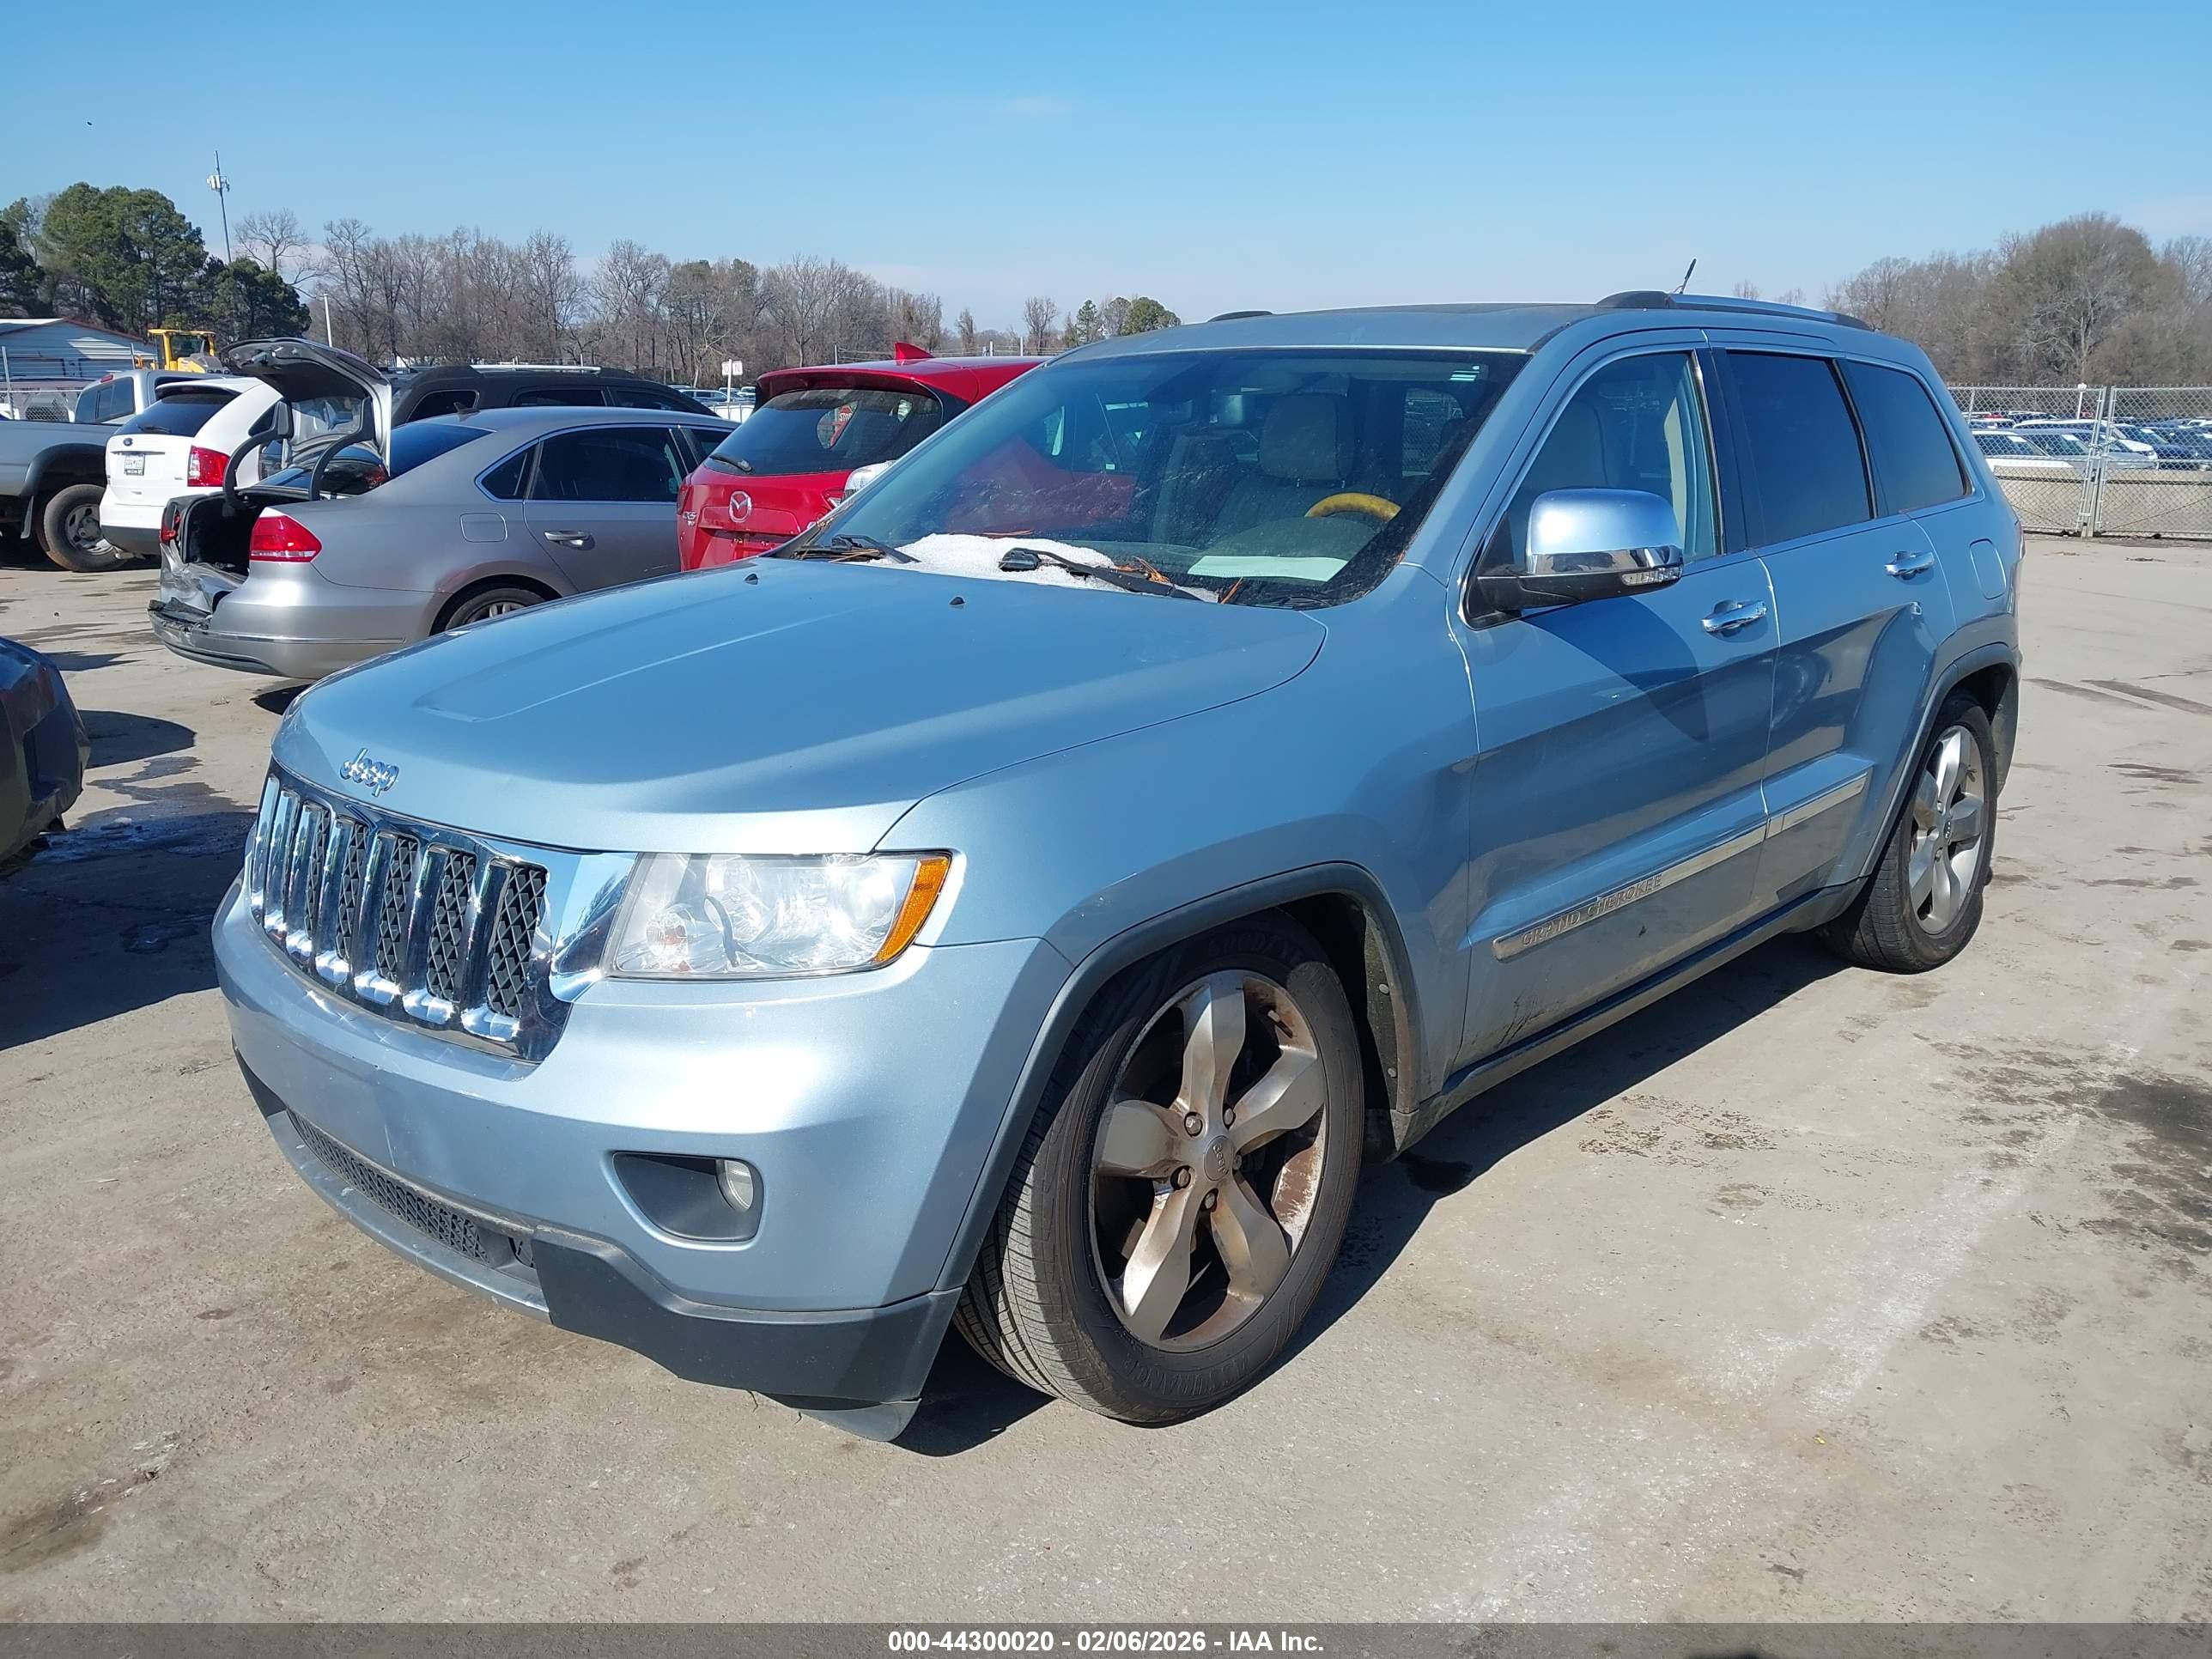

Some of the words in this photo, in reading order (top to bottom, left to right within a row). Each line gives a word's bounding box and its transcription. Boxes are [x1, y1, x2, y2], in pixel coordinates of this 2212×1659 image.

[340, 748, 399, 797] Jeep
[1522, 910, 1581, 945] GRAND
[1587, 873, 1662, 917] CHEROKEE
[1212, 1143, 1230, 1176] Jeep
